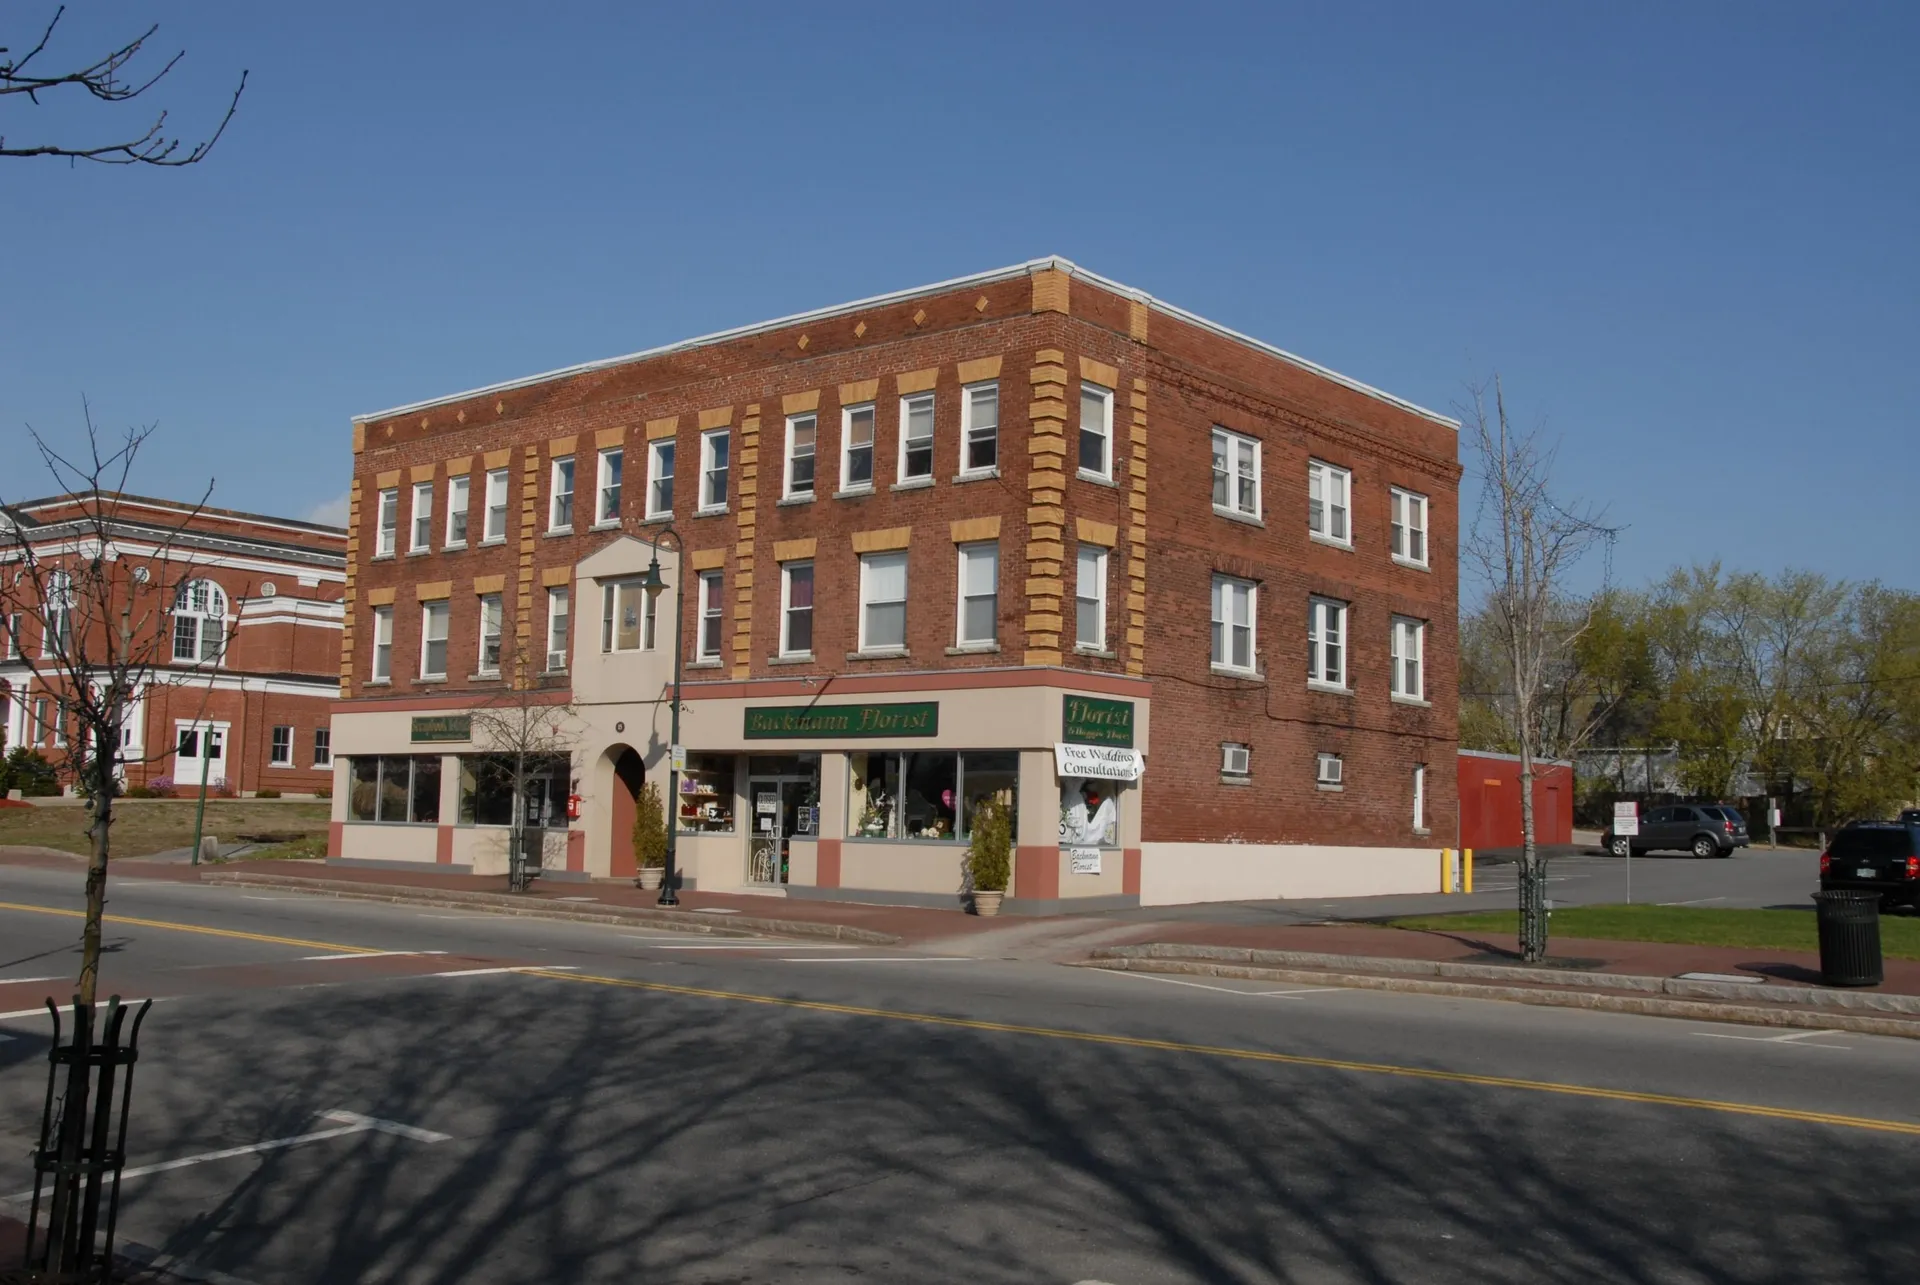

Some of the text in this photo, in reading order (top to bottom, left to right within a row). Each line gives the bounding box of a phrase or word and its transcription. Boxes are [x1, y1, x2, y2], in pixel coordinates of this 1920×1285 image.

[856, 708, 929, 731] Florist
[1067, 700, 1129, 726] Florist
[1064, 746, 1135, 764] Free Wedding
[1063, 762, 1138, 778] Consultations!
